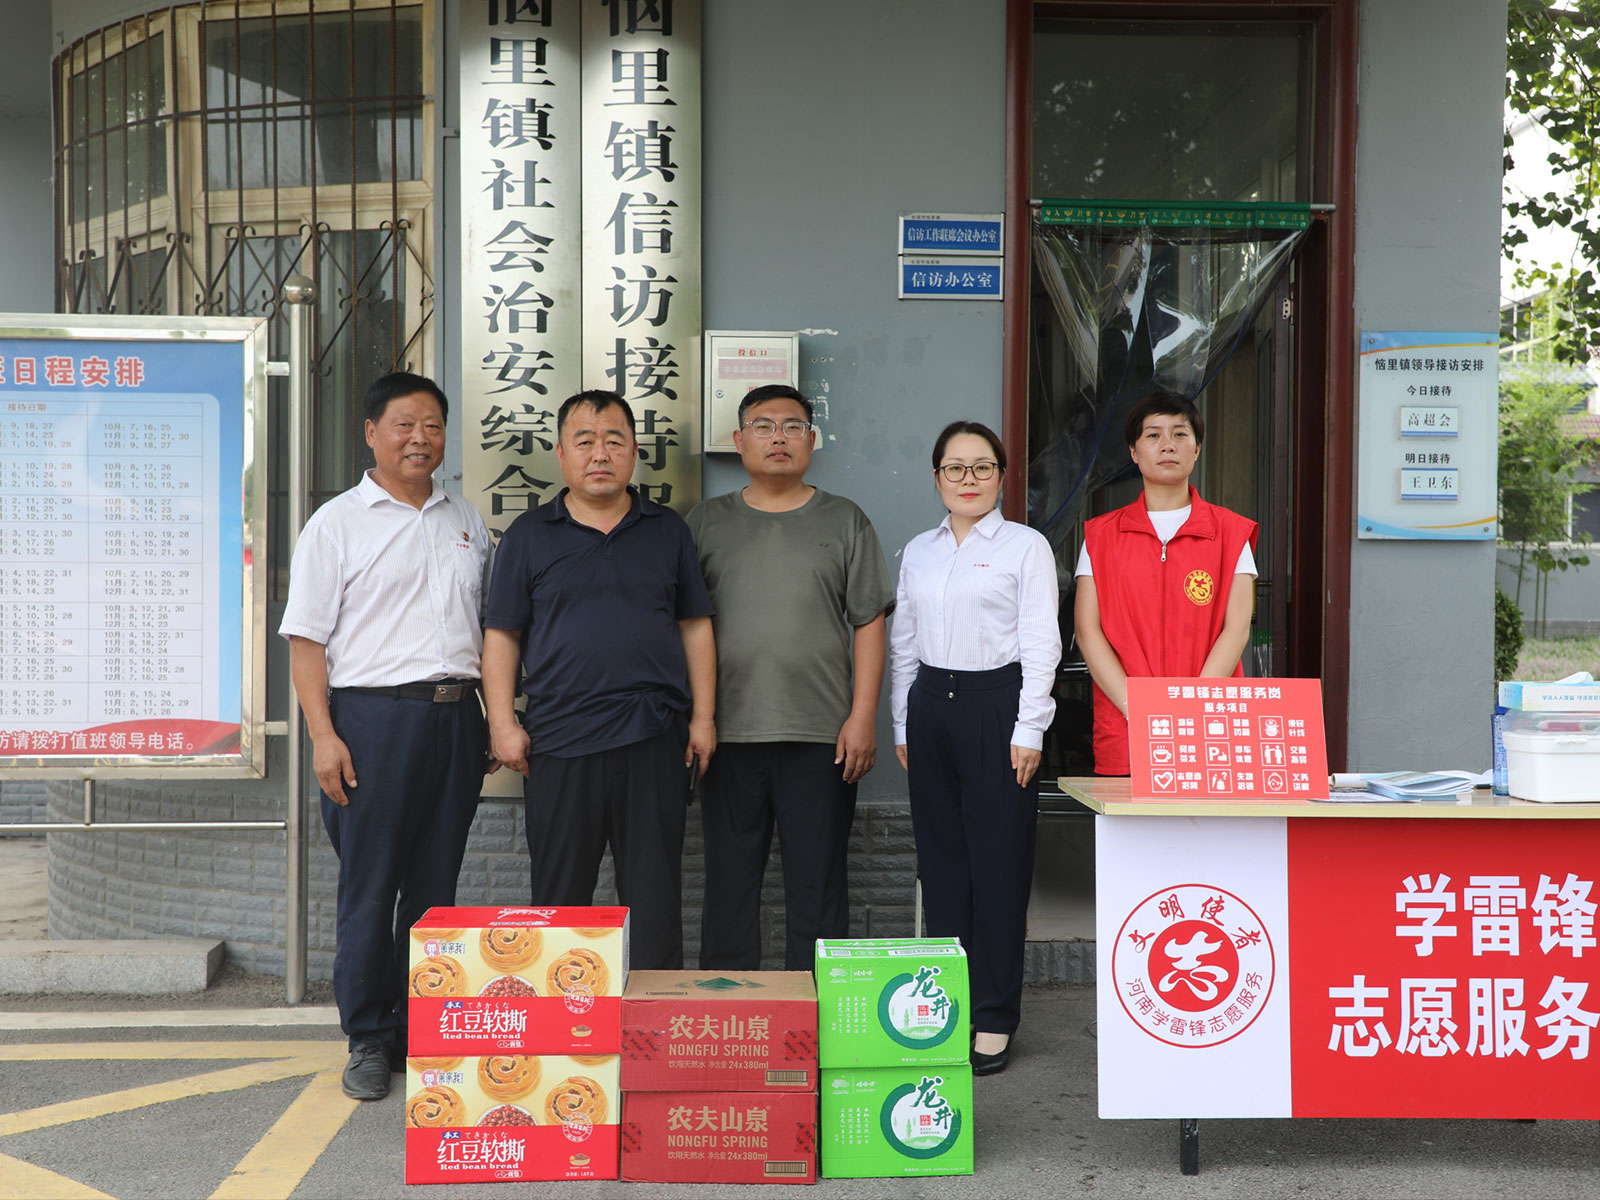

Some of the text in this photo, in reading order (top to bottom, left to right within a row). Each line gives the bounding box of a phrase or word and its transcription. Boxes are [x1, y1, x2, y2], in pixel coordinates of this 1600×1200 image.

[908, 228, 997, 243] 信访工作联席会议办公室
[912, 272, 992, 288] 信访办公室
[0, 355, 145, 387] 日程安排
[1375, 358, 1484, 372] 恼里镇领导接访安排
[1406, 385, 1452, 396] 今日接待
[8, 403, 47, 412] 接待日期
[1408, 413, 1451, 427] 高超会
[1405, 453, 1450, 464] 明日接待
[1412, 476, 1452, 490] 王卫东
[1168, 686, 1281, 699] 学雷锋志愿服务岗
[1204, 703, 1247, 713] 服务项目
[1395, 873, 1598, 957] 学雷锋
[1128, 893, 1262, 953] 文明使者
[907, 966, 949, 1020] 龙井
[1125, 971, 1263, 1037] 河南学雷锋志愿服务
[440, 1009, 528, 1032] 红豆软撕
[1327, 975, 1600, 1060] 志愿服务
[668, 1014, 770, 1041] 农夫山泉
[669, 1044, 769, 1057] NONGFU SPRING
[729, 1060, 769, 1069] 24x380ml
[910, 1077, 951, 1130] 龙井
[667, 1106, 768, 1132] 农夫山泉
[668, 1135, 768, 1148] NONGFU SPRING
[437, 1139, 526, 1163] 红豆软撕
[728, 1152, 768, 1160] 24x380ml
